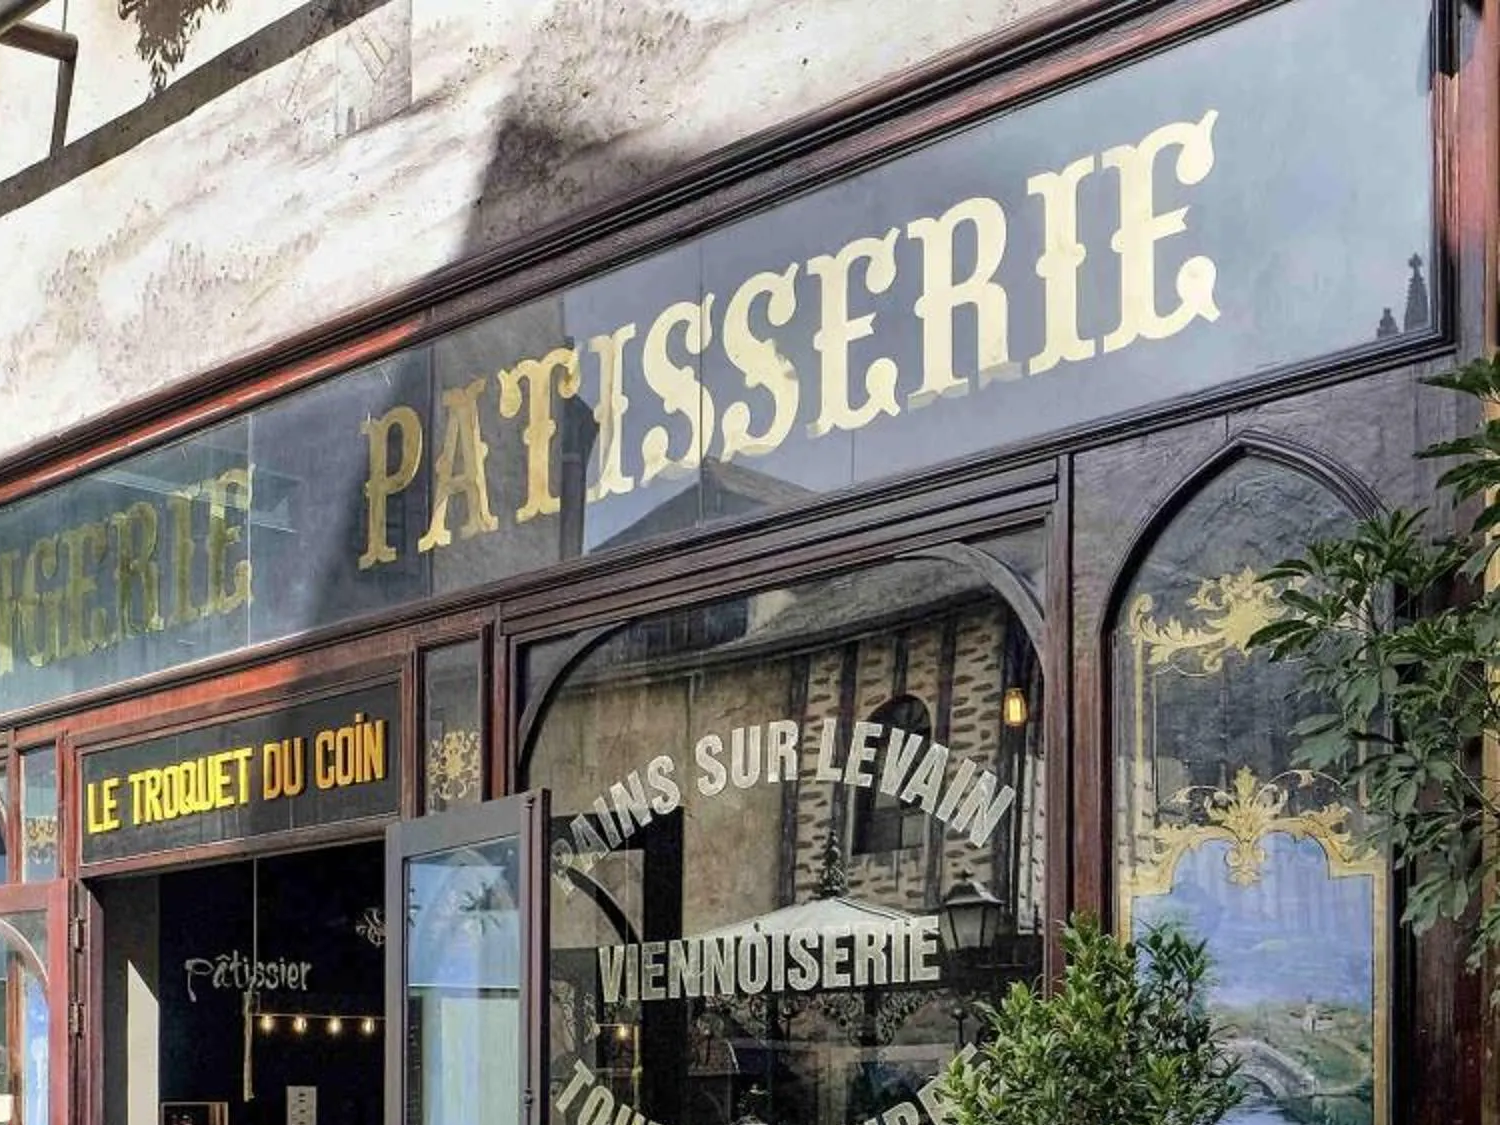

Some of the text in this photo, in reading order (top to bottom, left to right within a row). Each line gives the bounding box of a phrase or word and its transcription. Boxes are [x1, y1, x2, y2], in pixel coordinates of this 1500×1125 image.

[359, 110, 1222, 570] PATISSERIE
[87, 778, 120, 834] LE
[129, 748, 253, 824] TROQUET
[263, 737, 303, 800] DU
[696, 719, 799, 797] SUR
[815, 719, 1016, 848] LEVAIN
[599, 915, 941, 1003] VIENNOISERIE
